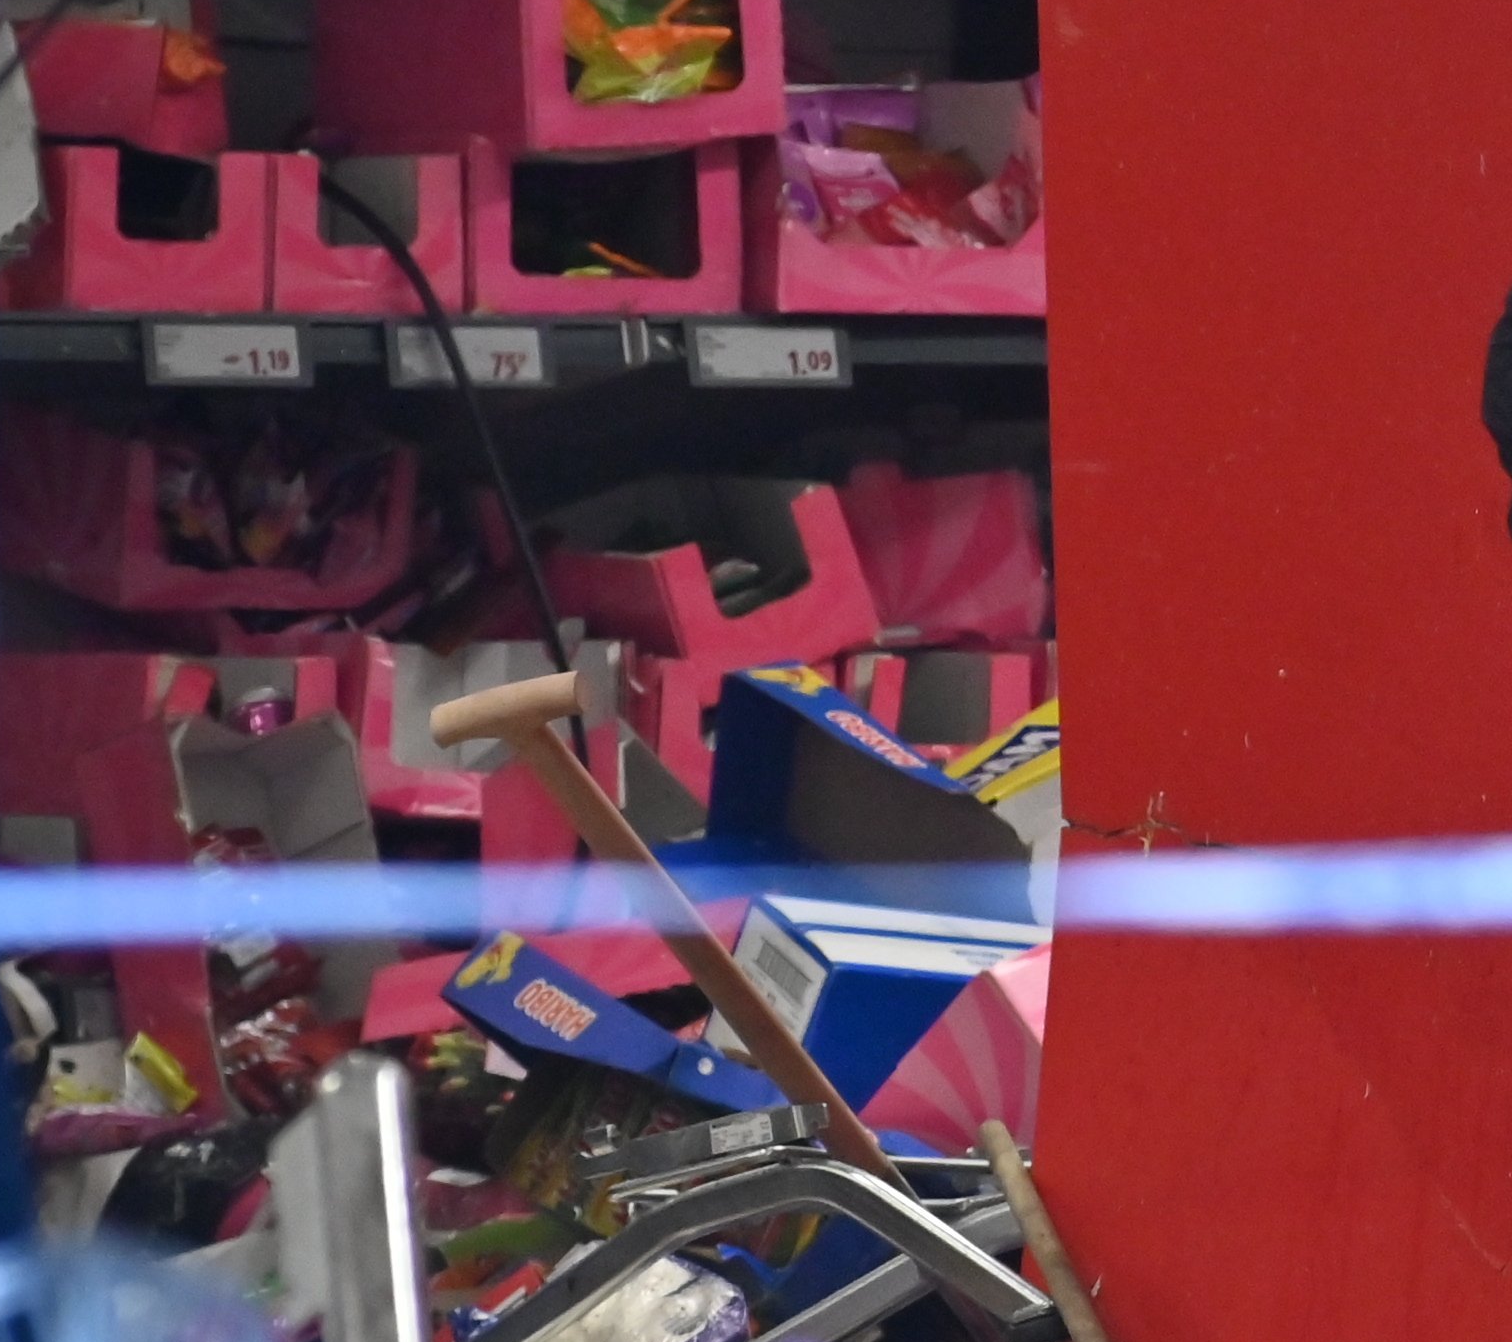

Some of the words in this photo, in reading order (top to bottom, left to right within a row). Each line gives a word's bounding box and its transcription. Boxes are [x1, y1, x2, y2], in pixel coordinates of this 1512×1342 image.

[248, 349, 290, 375] 1.19
[788, 350, 832, 375] 1.09
[514, 977, 597, 1042] HARIBO
